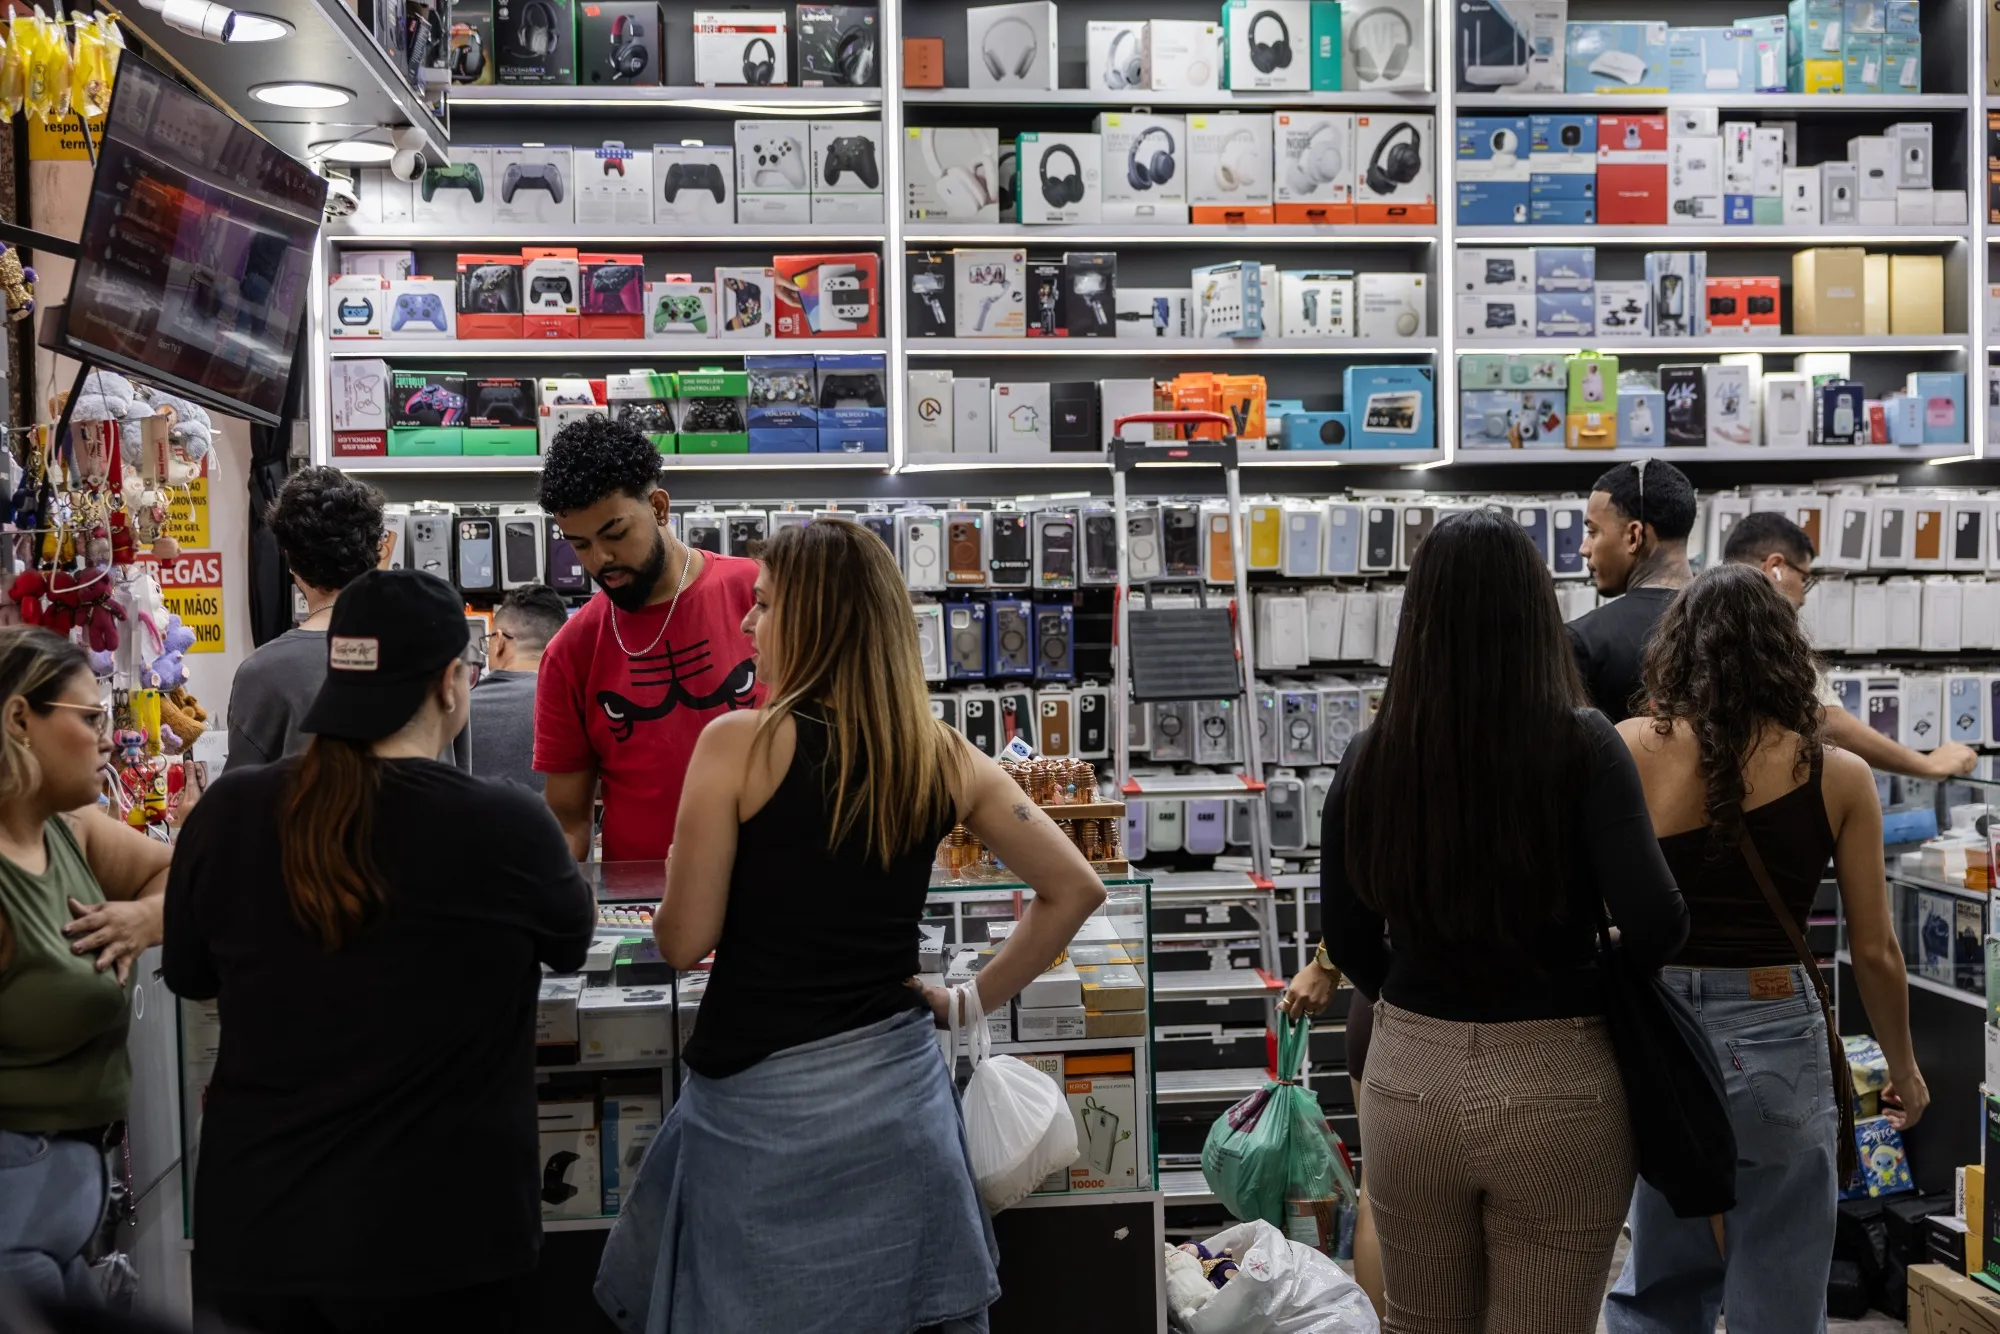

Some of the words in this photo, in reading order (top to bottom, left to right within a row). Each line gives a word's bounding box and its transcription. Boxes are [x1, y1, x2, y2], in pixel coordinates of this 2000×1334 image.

[184, 523, 201, 532] GEL
[184, 593, 218, 615] MÃOS
[1158, 812, 1175, 820] CASE
[1197, 813, 1215, 821] CASE
